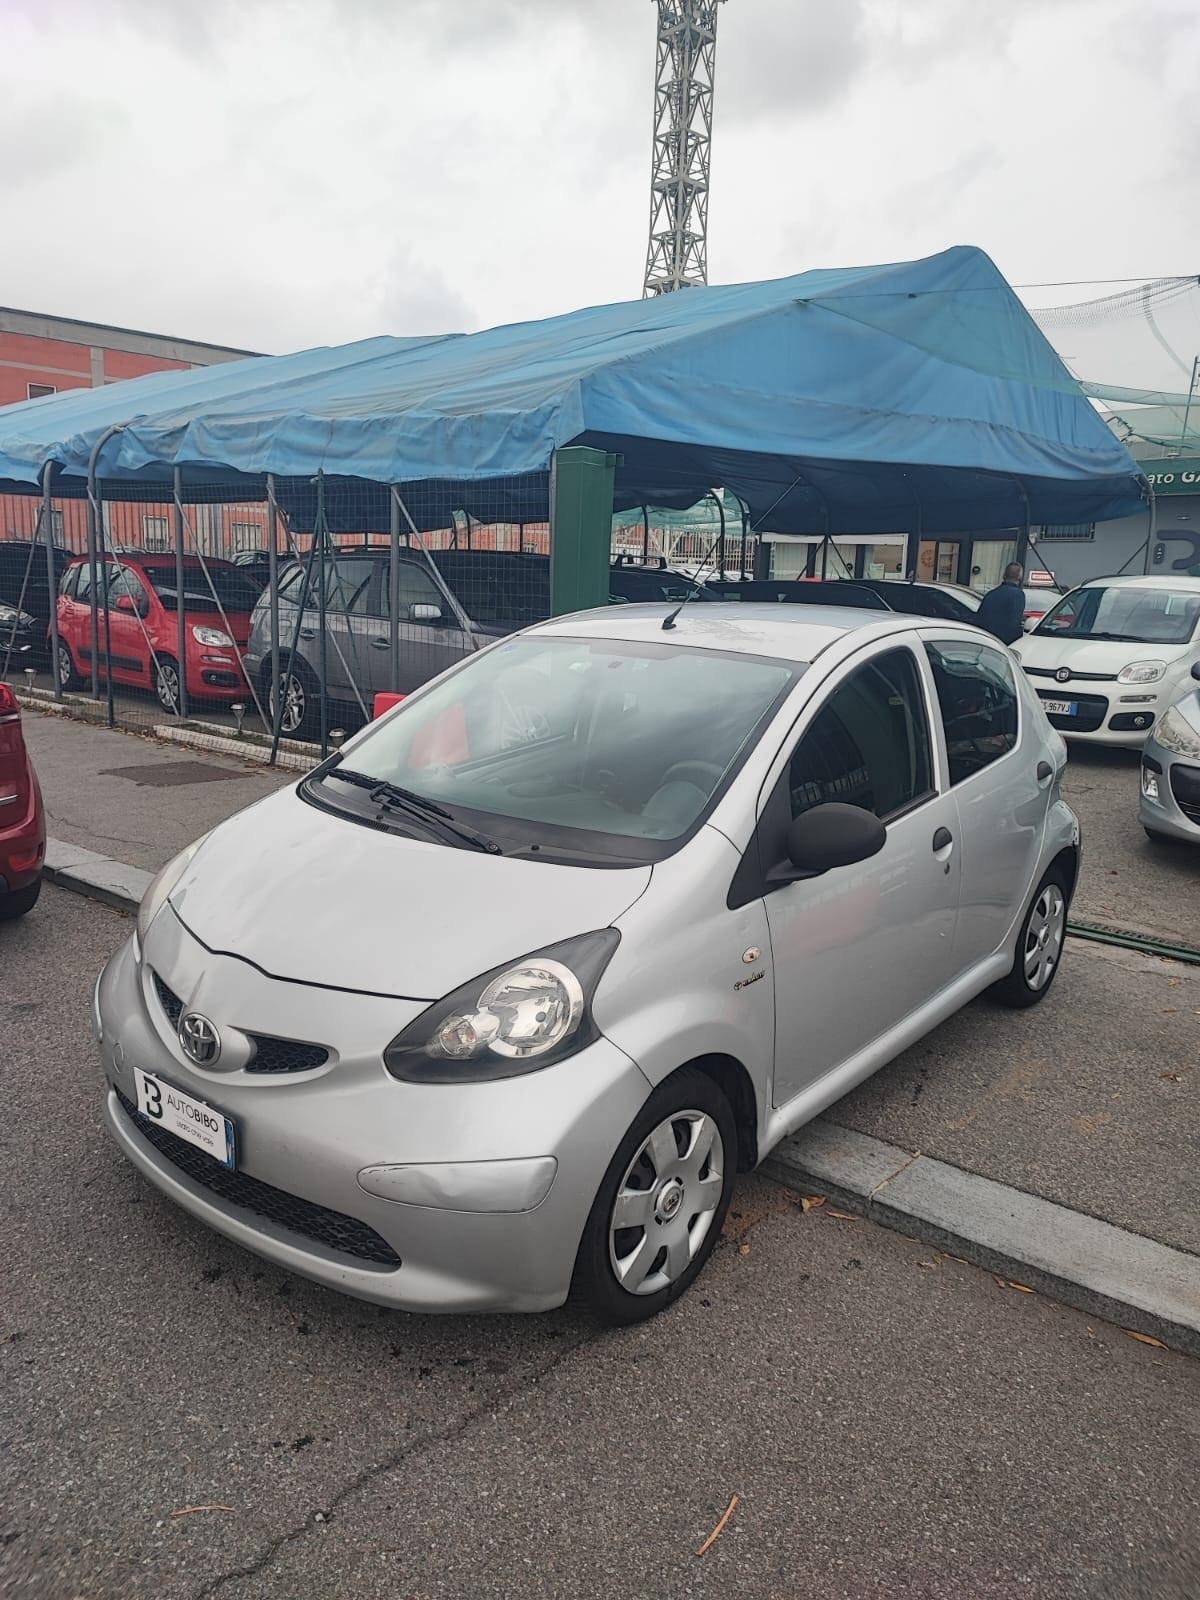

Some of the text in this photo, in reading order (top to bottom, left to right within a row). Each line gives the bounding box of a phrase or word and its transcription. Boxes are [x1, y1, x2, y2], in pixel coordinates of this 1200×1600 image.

[1147, 473, 1175, 484] ato
[1049, 702, 1070, 713] 967VJ
[167, 1094, 219, 1133] AUTOBIBO
